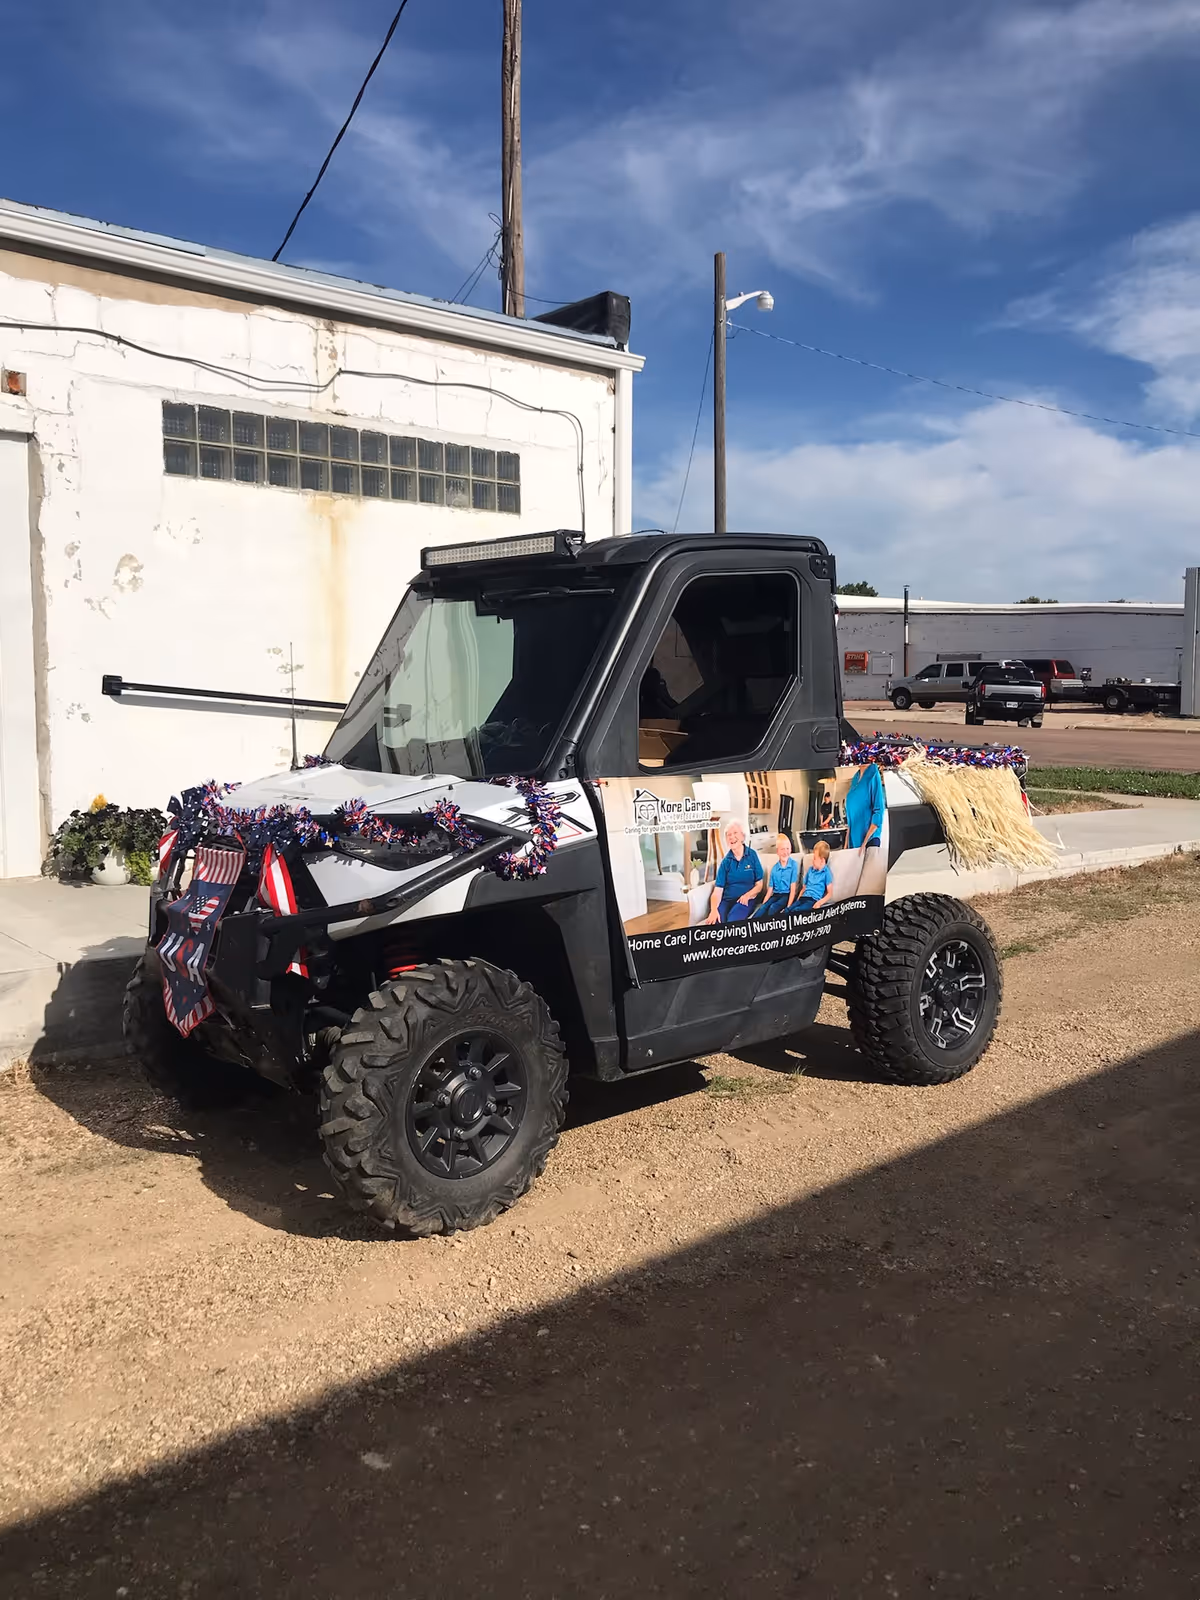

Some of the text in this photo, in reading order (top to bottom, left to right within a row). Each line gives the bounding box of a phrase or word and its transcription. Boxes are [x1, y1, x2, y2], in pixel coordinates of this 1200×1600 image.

[660, 799, 711, 813] Kore Cares
[624, 826, 641, 834] Caring
[674, 823, 686, 831] place
[687, 823, 696, 831] you
[628, 939, 661, 951] Home
[664, 934, 687, 946] Care
[694, 924, 747, 941] Caregiving
[753, 918, 787, 933] Nursing
[794, 910, 824, 926] Medical
[824, 907, 840, 918] Alert
[840, 900, 867, 915] Systems
[682, 940, 779, 963] www.korecares.com
[785, 924, 831, 946] 605-791-7970
[160, 932, 205, 986] USA
